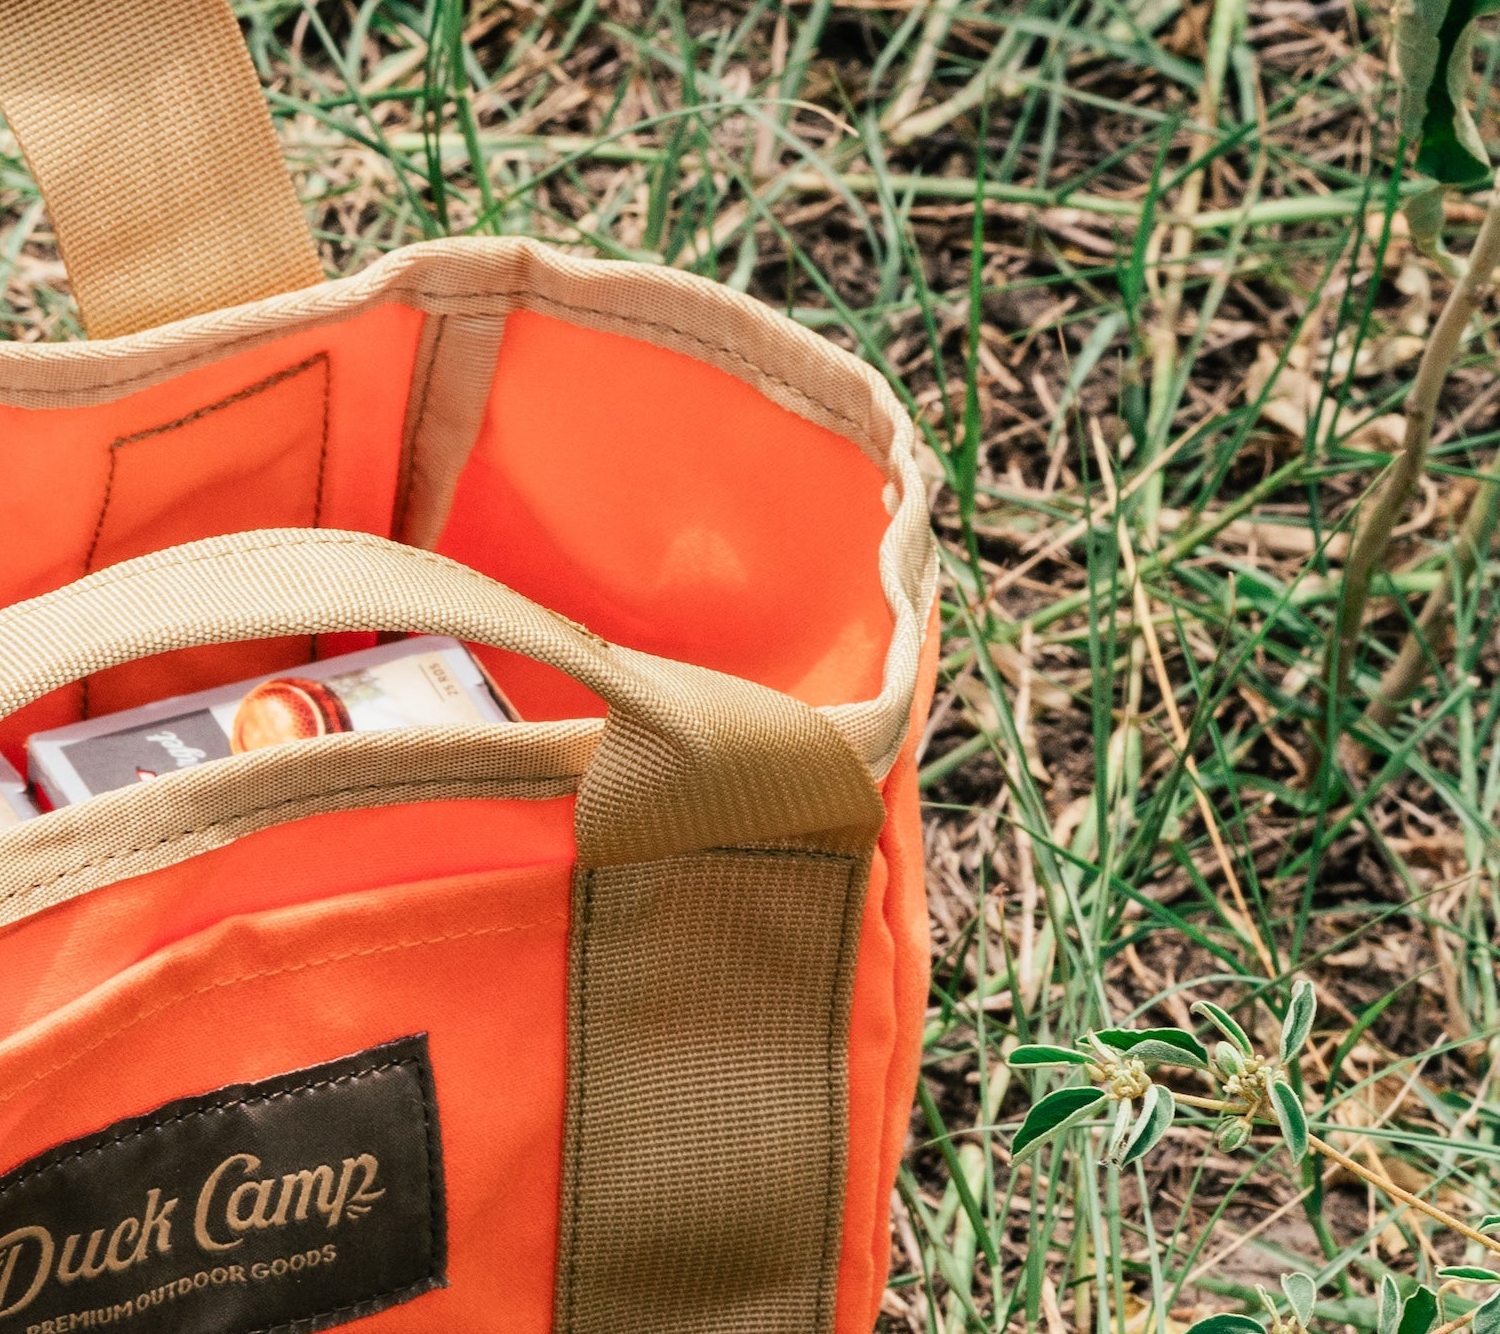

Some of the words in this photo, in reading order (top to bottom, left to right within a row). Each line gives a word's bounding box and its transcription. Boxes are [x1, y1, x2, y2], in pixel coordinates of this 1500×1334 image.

[146, 730, 207, 768] rget
[194, 1153, 386, 1251] Camp
[136, 1264, 247, 1311] OUTDOOR
[251, 1244, 338, 1282] GOODS
